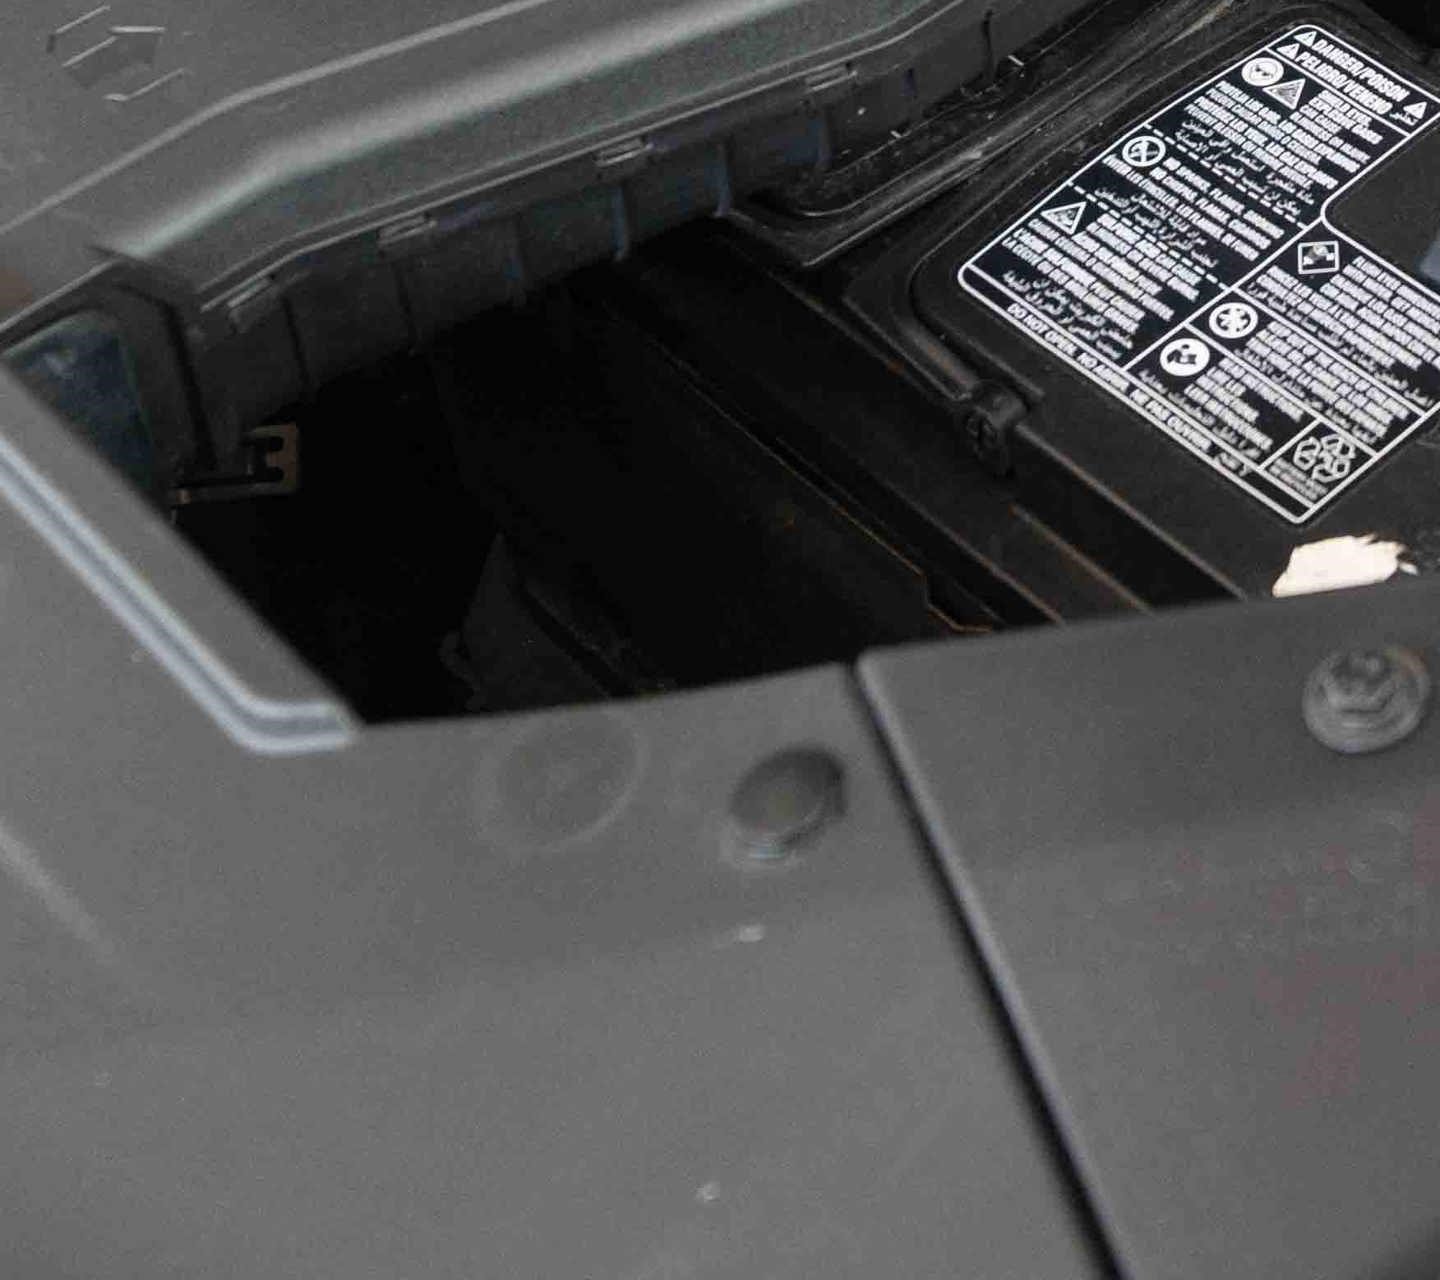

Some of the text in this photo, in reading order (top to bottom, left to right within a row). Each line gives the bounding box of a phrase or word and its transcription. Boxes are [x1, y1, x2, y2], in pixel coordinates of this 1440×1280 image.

[1290, 51, 1396, 114] PELIGRO/VENENO
[1307, 38, 1413, 101] DANGER/POISON
[1005, 302, 1029, 319] DO
[1021, 313, 1050, 334] NOT
